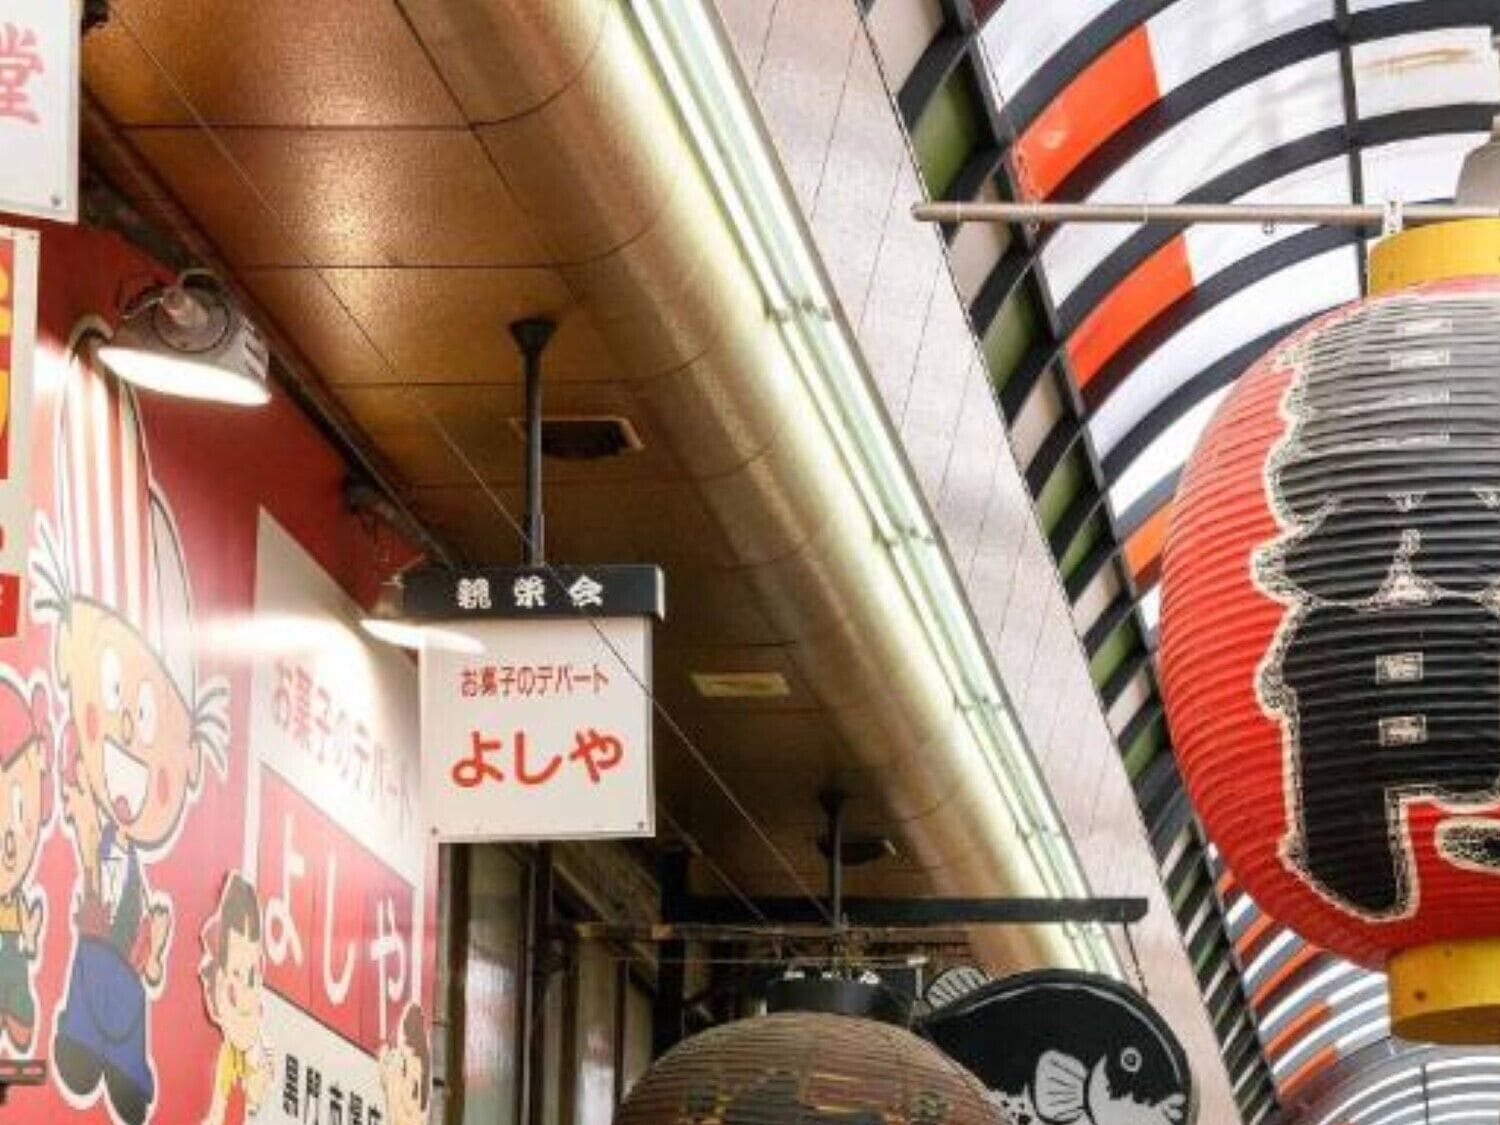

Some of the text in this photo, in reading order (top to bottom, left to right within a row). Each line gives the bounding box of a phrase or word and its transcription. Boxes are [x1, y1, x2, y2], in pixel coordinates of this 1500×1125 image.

[460, 663, 610, 697] お菓子のデパート
[451, 727, 624, 788] よしや
[264, 814, 407, 1045] よしや
